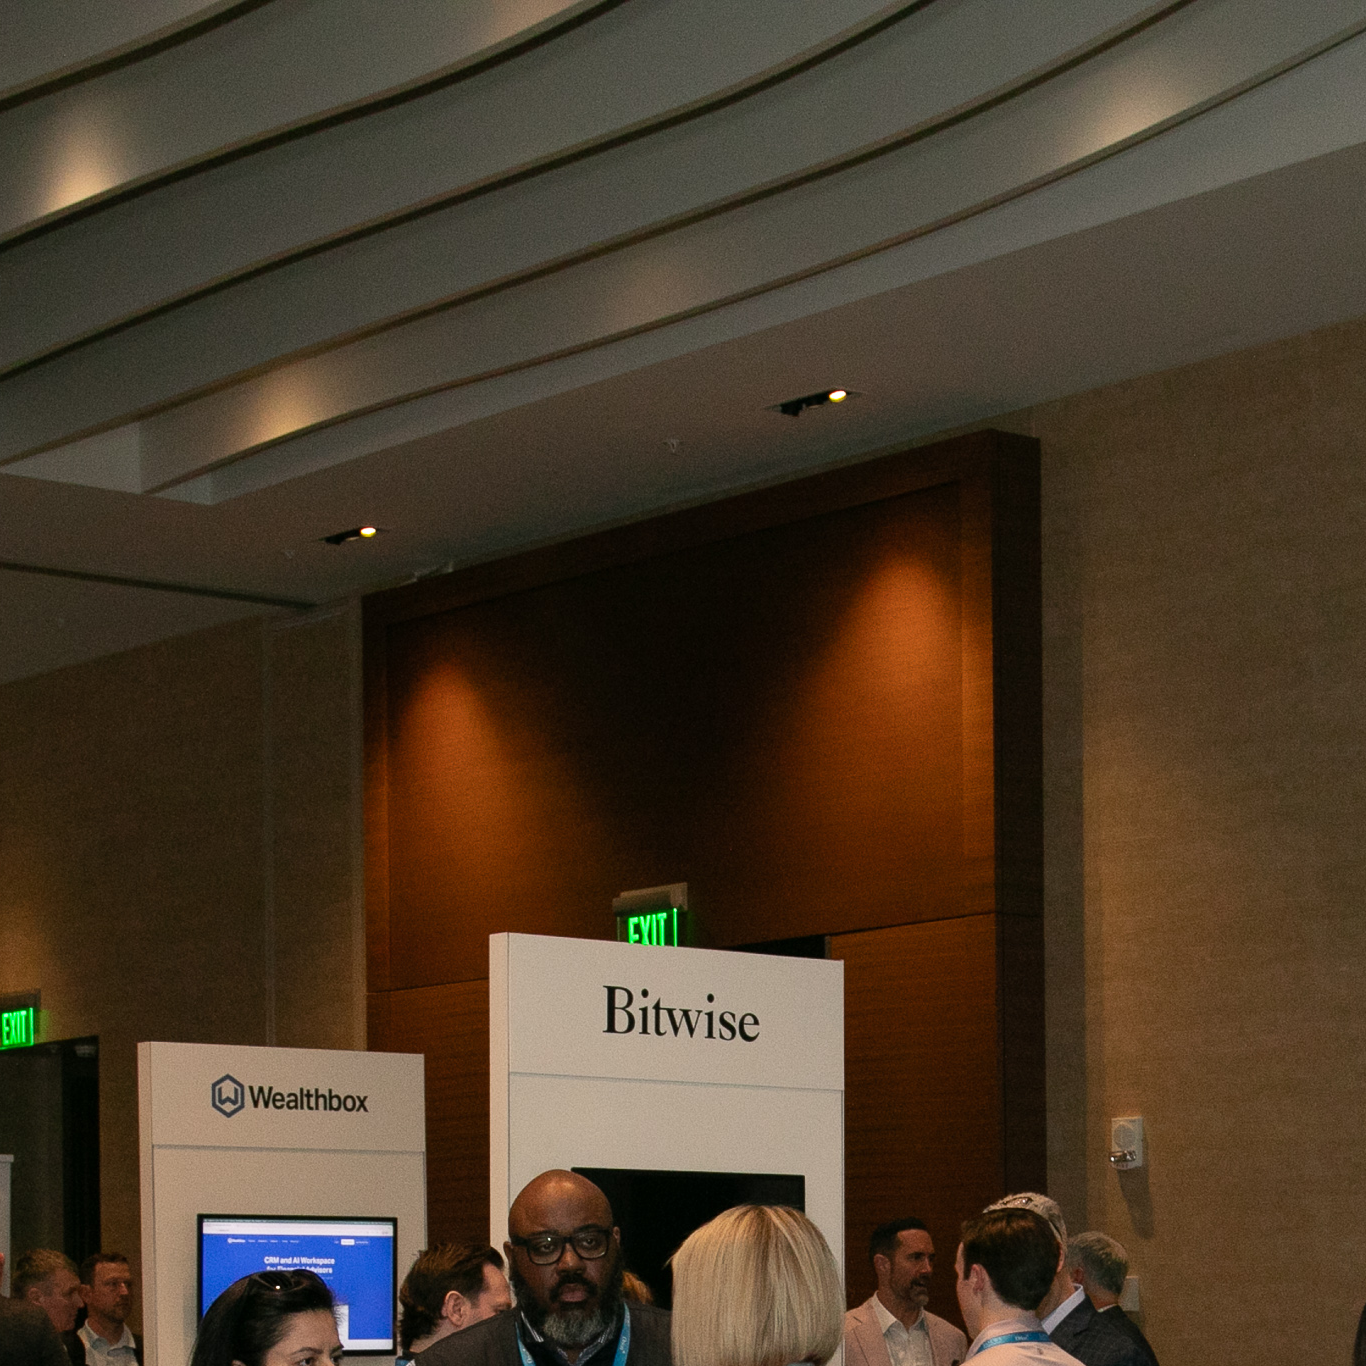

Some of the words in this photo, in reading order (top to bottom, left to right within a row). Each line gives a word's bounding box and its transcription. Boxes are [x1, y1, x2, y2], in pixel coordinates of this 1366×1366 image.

[628, 912, 667, 946] EXIT
[2, 1010, 27, 1046] EXIT
[602, 985, 760, 1042] Bitwise
[248, 1085, 369, 1113] Wealthbox
